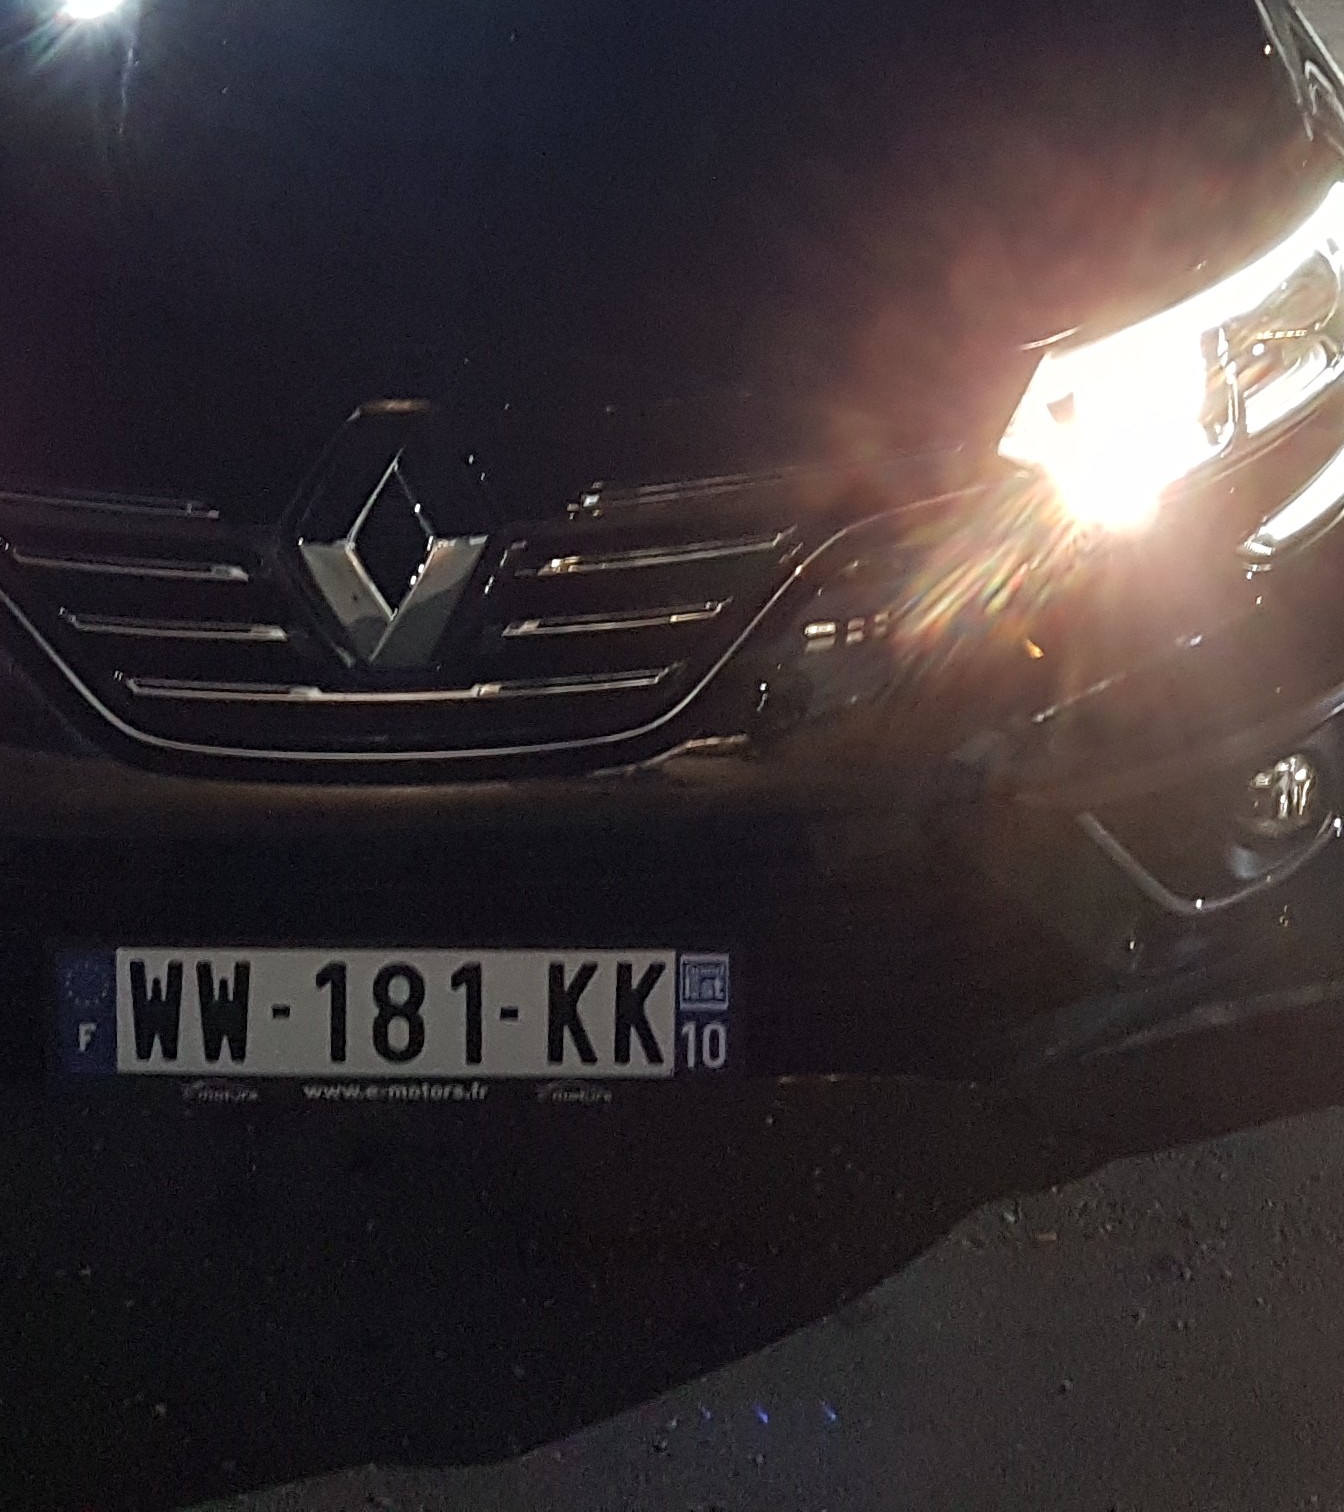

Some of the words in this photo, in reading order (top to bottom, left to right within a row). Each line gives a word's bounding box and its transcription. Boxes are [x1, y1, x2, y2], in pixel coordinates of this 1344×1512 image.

[129, 960, 666, 1065] WW-181-KK
[78, 1022, 97, 1052] F
[681, 1021, 726, 1069] 10
[302, 1082, 489, 1101] www.e-motors.fr
